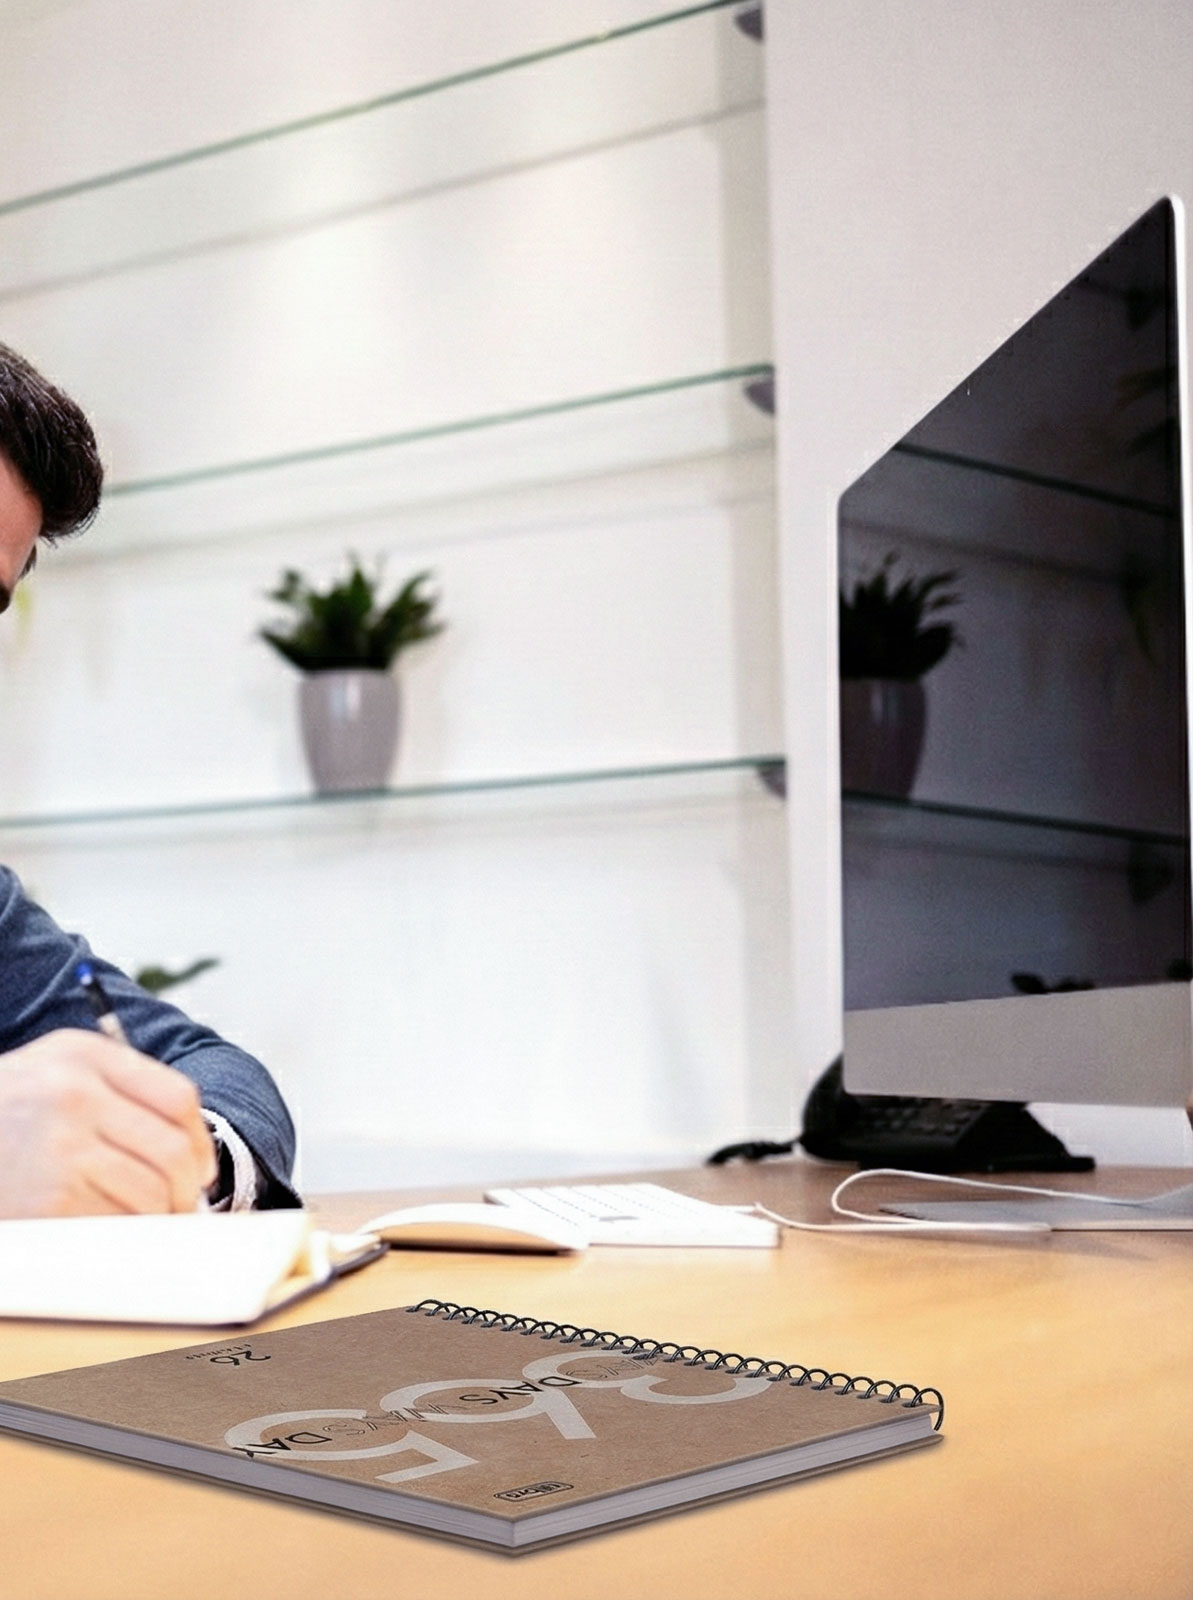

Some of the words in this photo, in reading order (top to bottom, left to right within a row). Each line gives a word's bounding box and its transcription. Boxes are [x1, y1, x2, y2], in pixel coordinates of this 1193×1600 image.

[210, 1350, 271, 1366] 26
[459, 1376, 582, 1405] DAYS
[224, 1349, 774, 1483] 365
[232, 1431, 332, 1458] DAY
